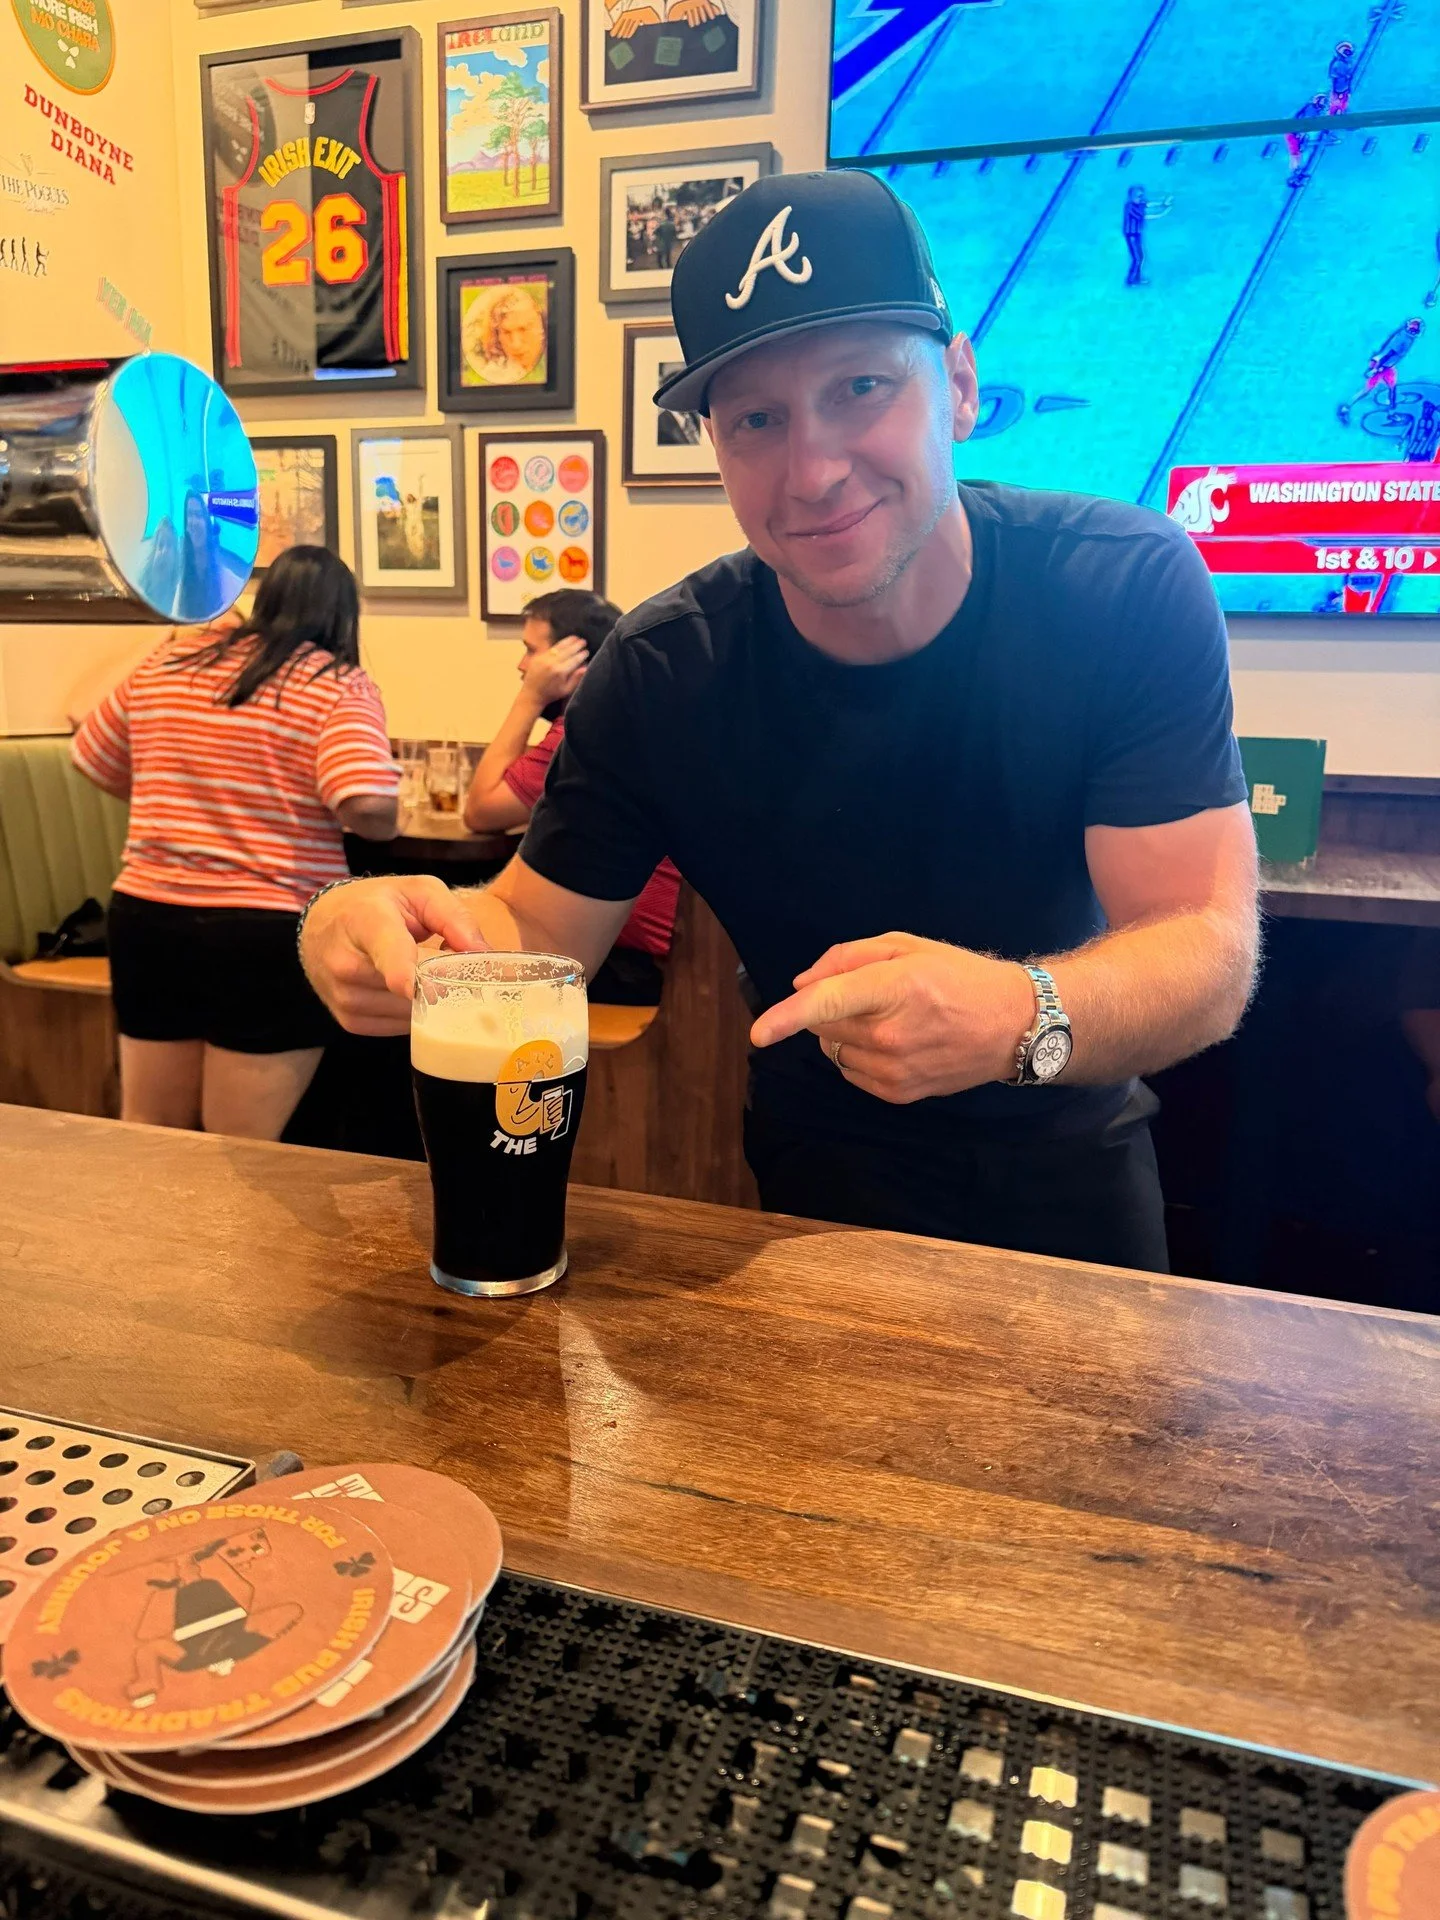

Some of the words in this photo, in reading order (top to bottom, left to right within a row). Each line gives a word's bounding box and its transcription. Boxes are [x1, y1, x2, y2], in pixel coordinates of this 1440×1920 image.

[24, 83, 134, 172] DUNBOYNE
[51, 128, 116, 185] DIANA
[258, 137, 311, 187] IRISH
[313, 136, 361, 179] EXIT
[261, 193, 369, 286] 26
[1250, 481, 1381, 504] WASHINGTON
[1383, 480, 1440, 502] STATE
[1315, 548, 1352, 570] 1st
[1355, 547, 1379, 570] &
[1383, 547, 1414, 570] 10
[490, 1129, 537, 1155] THE
[155, 1509, 202, 1532] ON
[206, 1503, 300, 1525] THOSE
[300, 1515, 347, 1549] FOR
[36, 1539, 123, 1634] JOURNEY
[328, 1587, 376, 1650] IRISH
[271, 1648, 342, 1697] PUB
